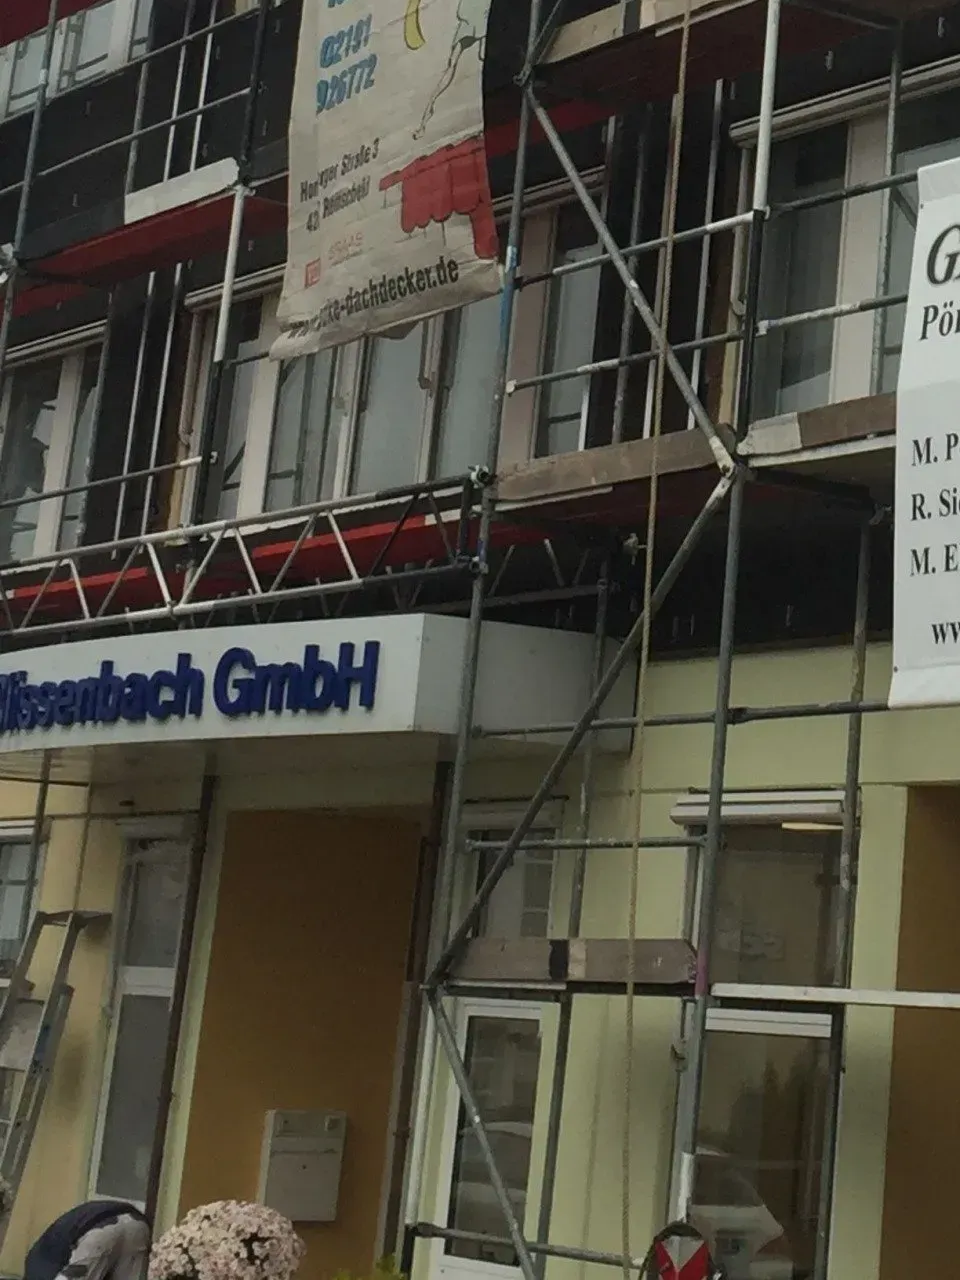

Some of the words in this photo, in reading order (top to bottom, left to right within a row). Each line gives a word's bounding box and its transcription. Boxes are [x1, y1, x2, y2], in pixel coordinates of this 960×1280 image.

[320, 14, 373, 69] 02191
[316, 54, 377, 115] 926772
[341, 144, 372, 176] Straße
[371, 138, 380, 159] 3
[911, 438, 939, 467] M.
[911, 492, 934, 521] R.
[910, 548, 938, 577] M.
[213, 641, 381, 717] GmbH
